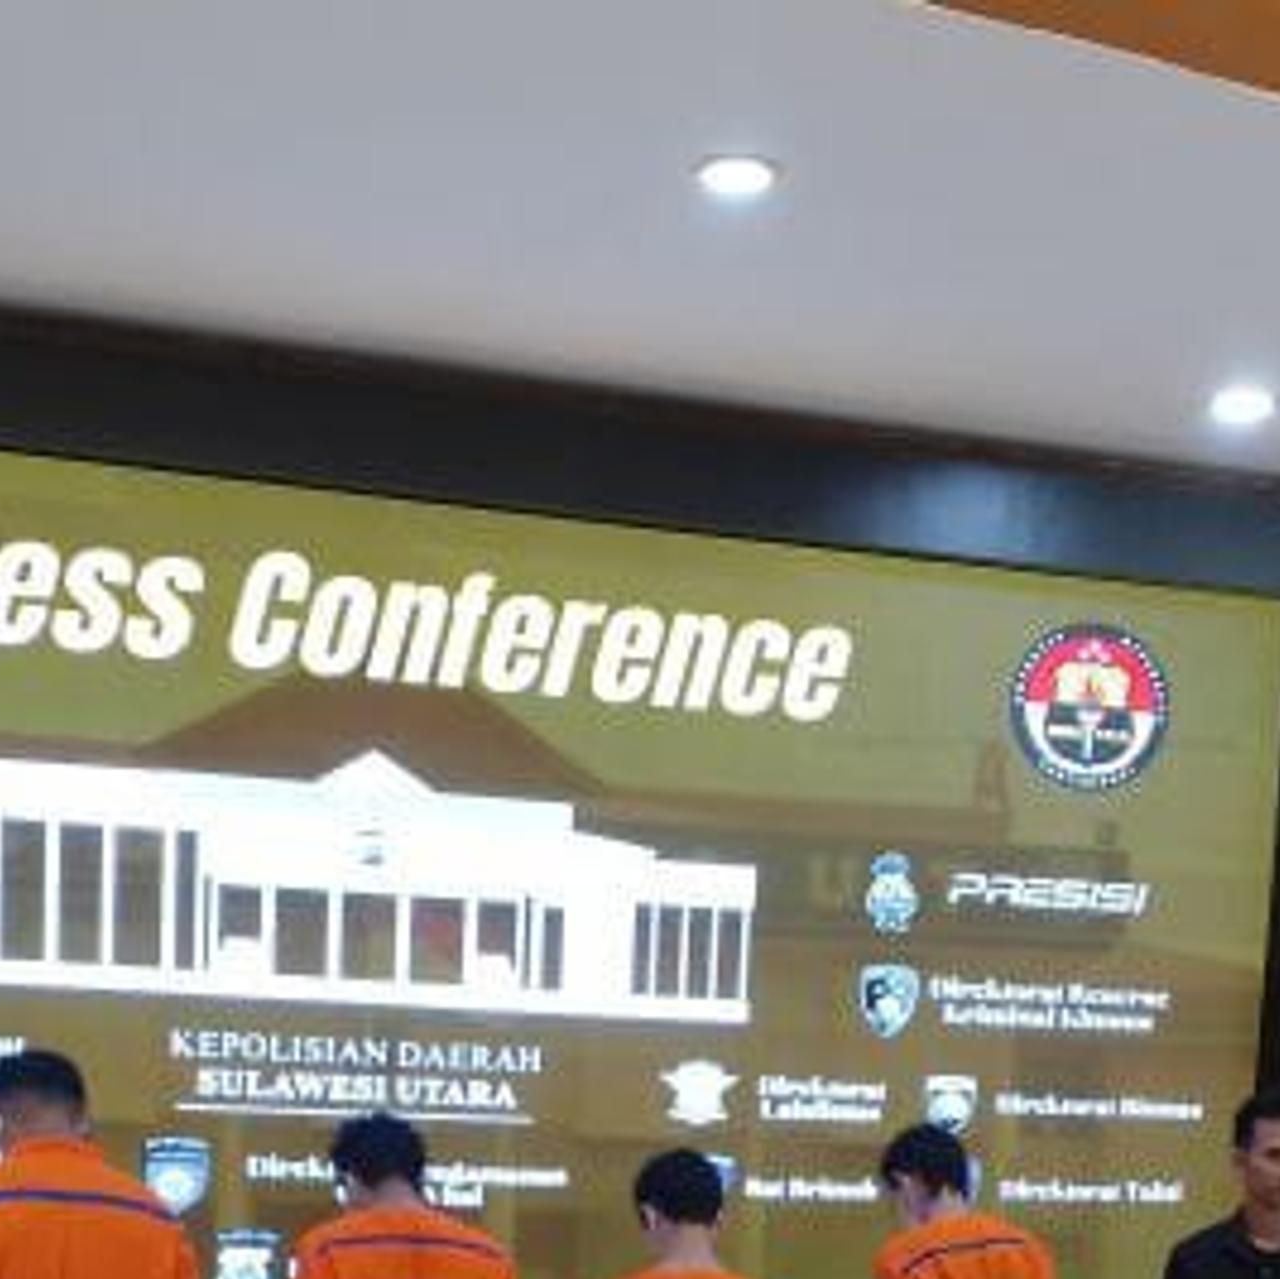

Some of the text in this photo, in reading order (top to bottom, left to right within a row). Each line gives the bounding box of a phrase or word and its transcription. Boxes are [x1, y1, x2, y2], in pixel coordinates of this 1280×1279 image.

[228, 549, 854, 723] Conference
[946, 872, 1151, 917] PRESISI
[169, 1029, 543, 1074] KEPOLISIAN DAERAH
[196, 1069, 516, 1109] SULAWESI UTARA
